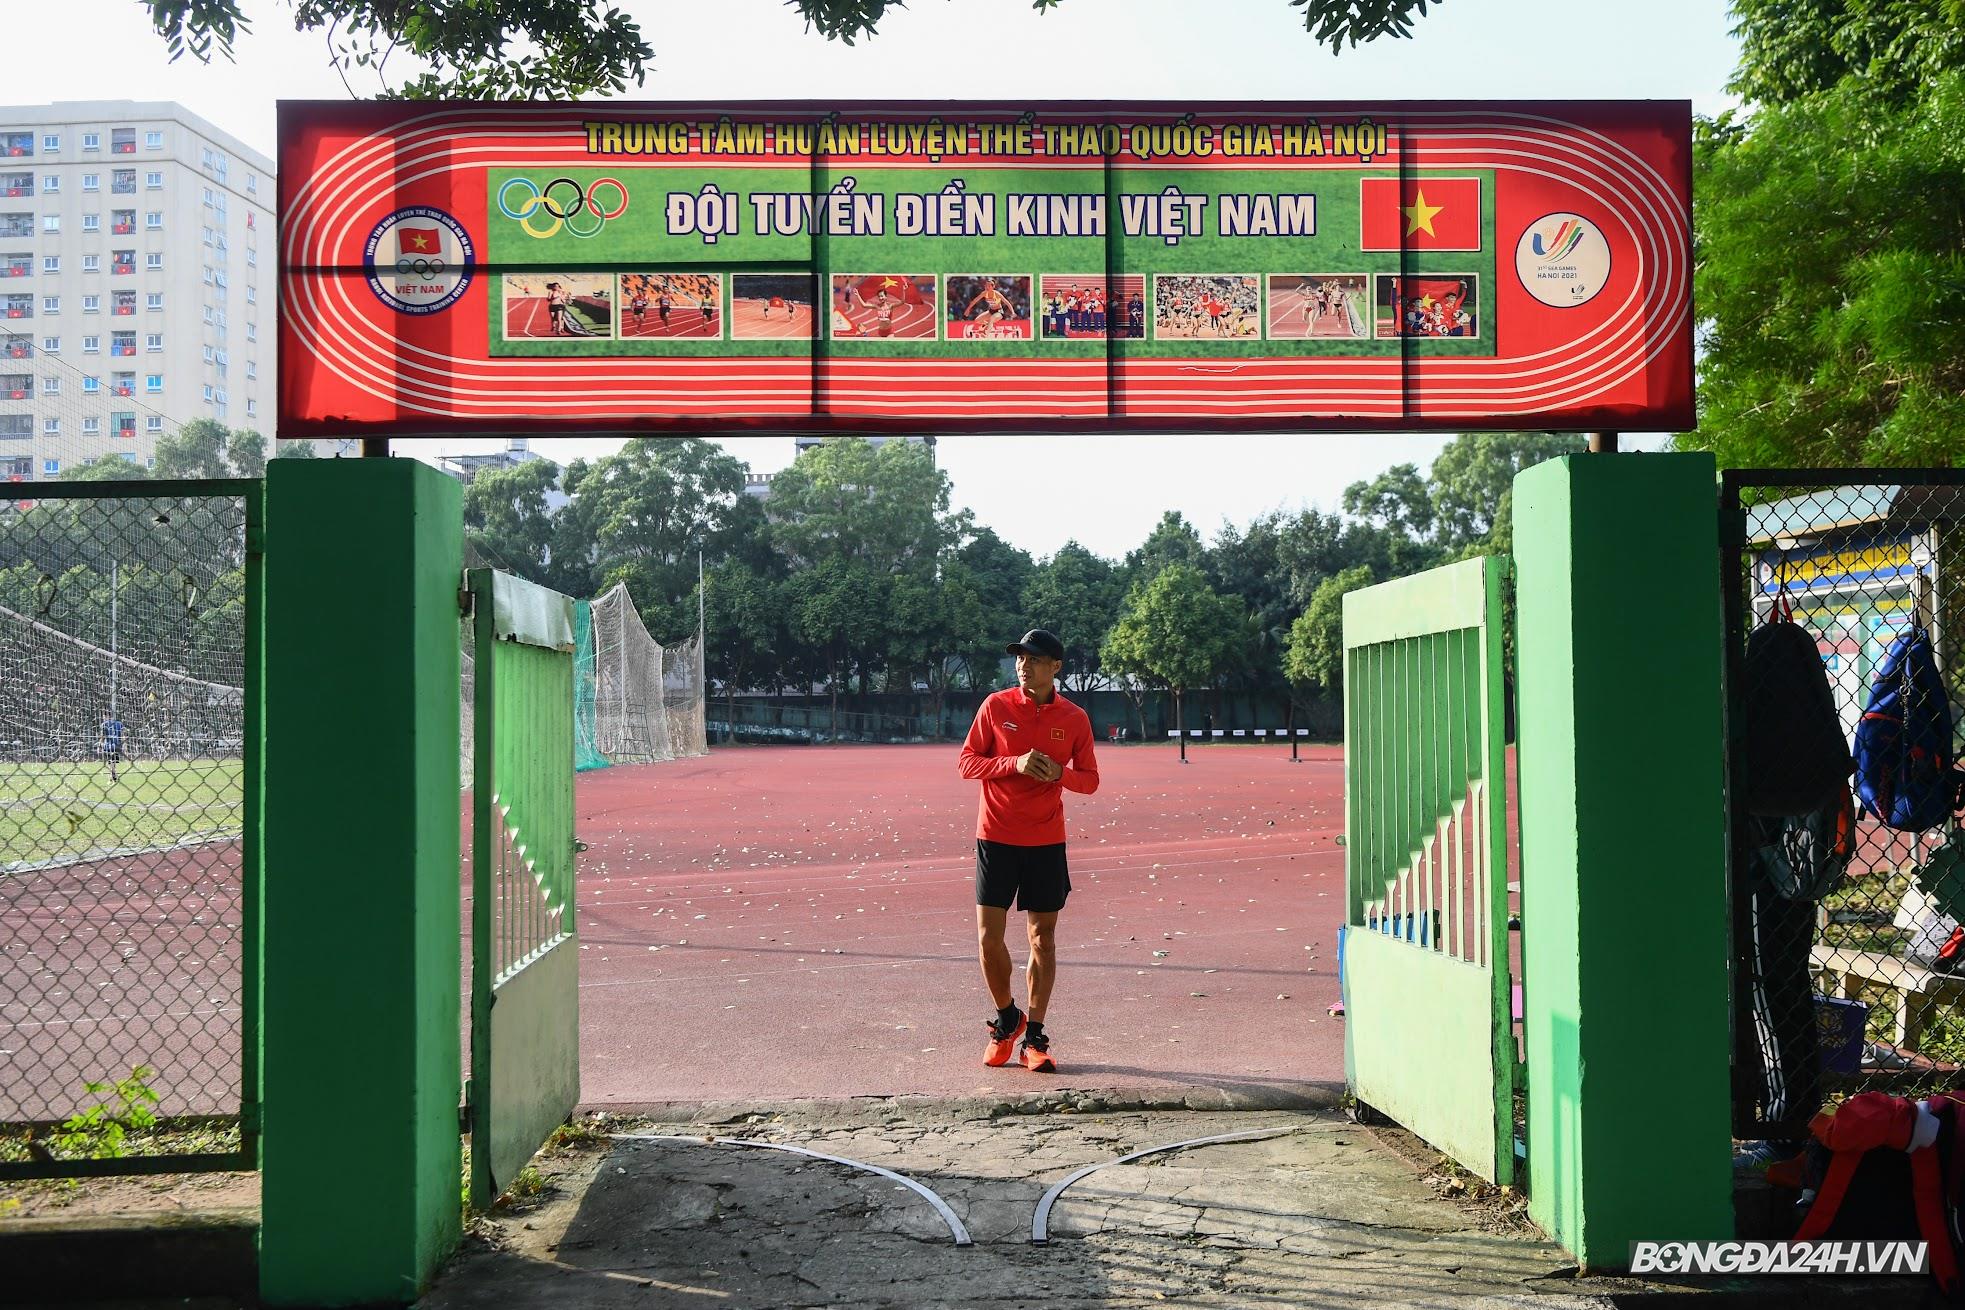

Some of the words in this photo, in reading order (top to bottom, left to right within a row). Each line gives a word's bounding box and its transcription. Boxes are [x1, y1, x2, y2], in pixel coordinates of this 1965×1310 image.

[583, 120, 690, 154] TRUNG
[698, 116, 768, 155] TÂM
[771, 111, 865, 155] HUẤN
[869, 116, 969, 162] LUYỆN
[977, 112, 1035, 155] THỂ
[1043, 123, 1121, 156] THAO
[1130, 113, 1215, 160] QUỐC
[1222, 123, 1276, 156] GIA
[1283, 119, 1326, 156] HÀ
[1331, 116, 1387, 162] NỘI
[665, 183, 739, 244] ĐỘI
[749, 176, 885, 235] TUYỂN
[894, 179, 994, 236] ĐIỀN
[1007, 193, 1107, 237] KINH
[1120, 185, 1208, 245] VIỆT
[1218, 193, 1316, 236] NAM
[395, 283, 418, 297] VIỆT
[420, 285, 445, 294] NAM
